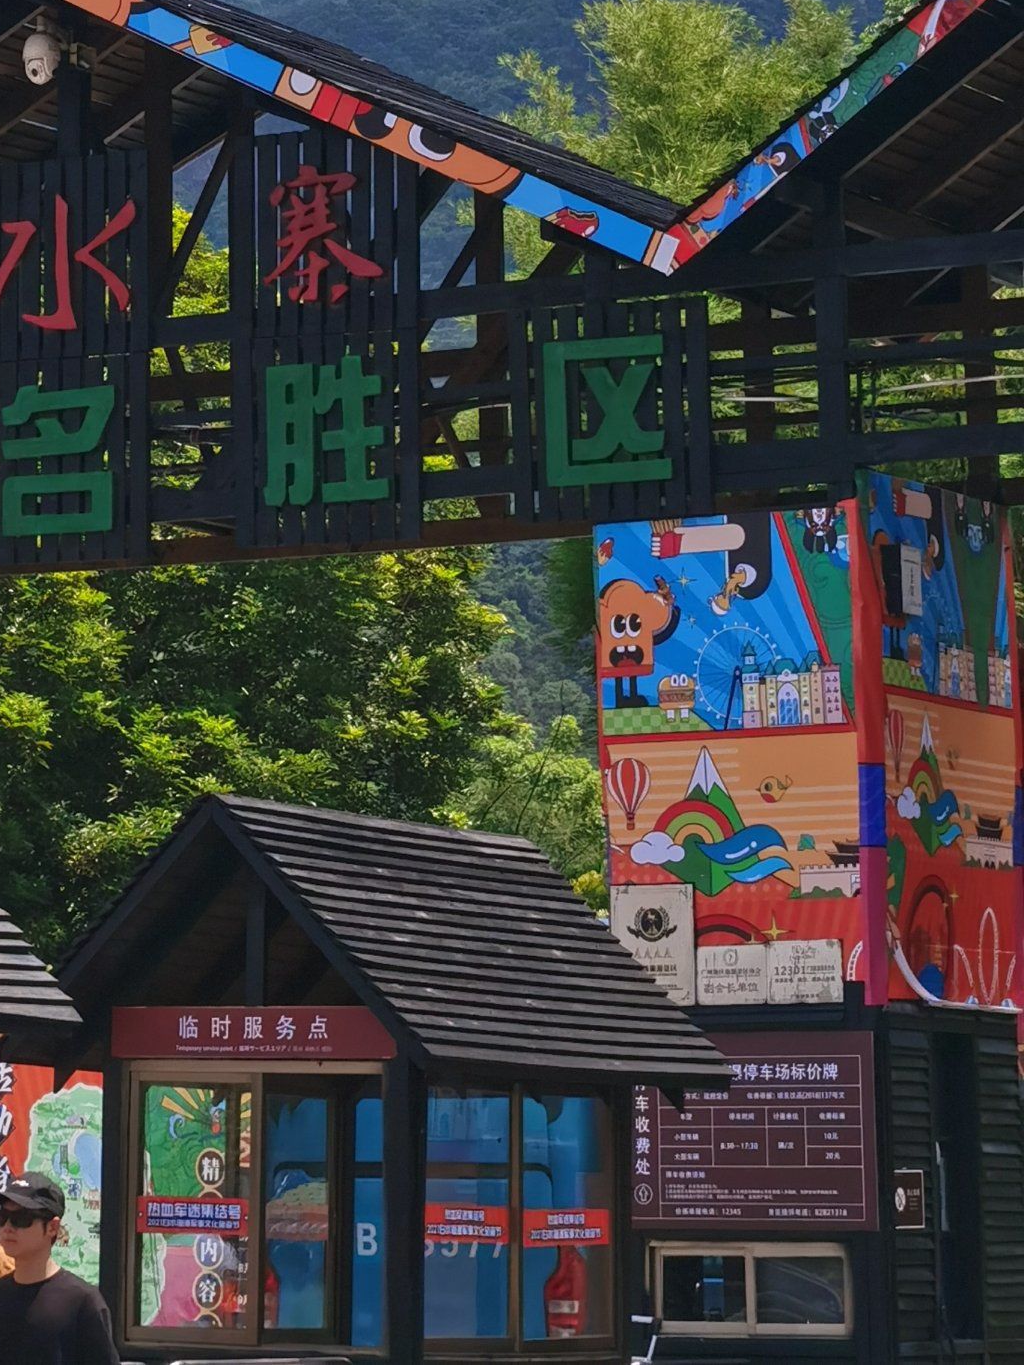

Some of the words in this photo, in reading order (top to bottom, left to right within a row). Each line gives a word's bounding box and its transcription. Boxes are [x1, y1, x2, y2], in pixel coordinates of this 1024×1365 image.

[178, 1014, 328, 1040] 临时服务点
